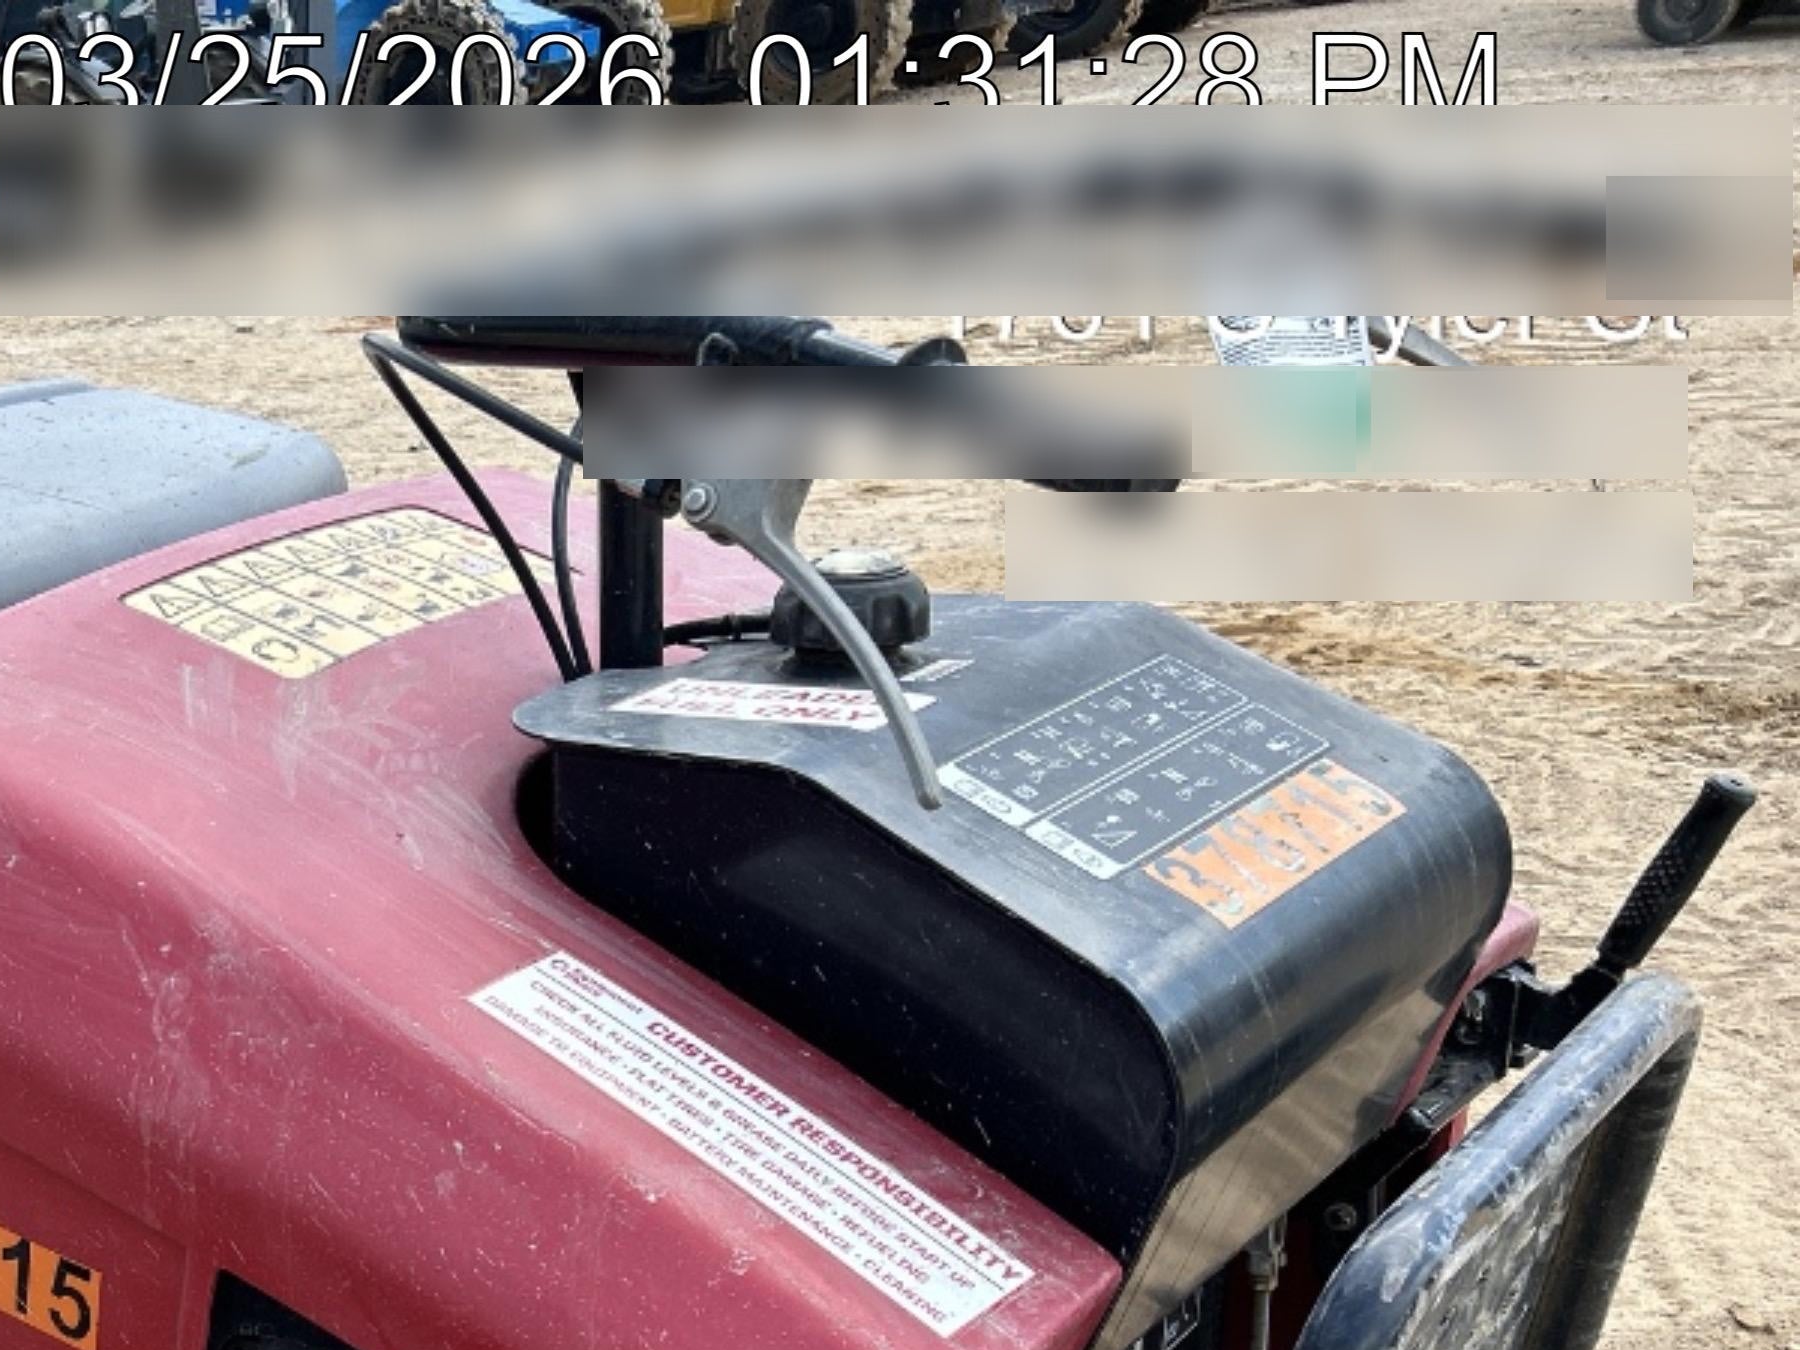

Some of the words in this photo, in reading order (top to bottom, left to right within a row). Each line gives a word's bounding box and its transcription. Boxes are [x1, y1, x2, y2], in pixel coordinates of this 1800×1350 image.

[752, 703, 880, 722] ONLY
[580, 1013, 605, 1031] ALL
[608, 1031, 652, 1063] FLUID
[654, 1061, 708, 1100] LEVELS
[723, 1109, 781, 1151] GREASE
[785, 1152, 831, 1186] DAILY
[831, 1186, 895, 1232] BEFORE
[896, 1232, 949, 1271] START
[951, 1271, 974, 1290] UP
[647, 1021, 785, 1117] CUSTOMER
[786, 1117, 1023, 1282] RESPONSIBILITY
[735, 1166, 855, 1253] MAINTENANCE
[862, 1259, 949, 1322] CLEANING
[837, 1215, 931, 1283] REFUELING
